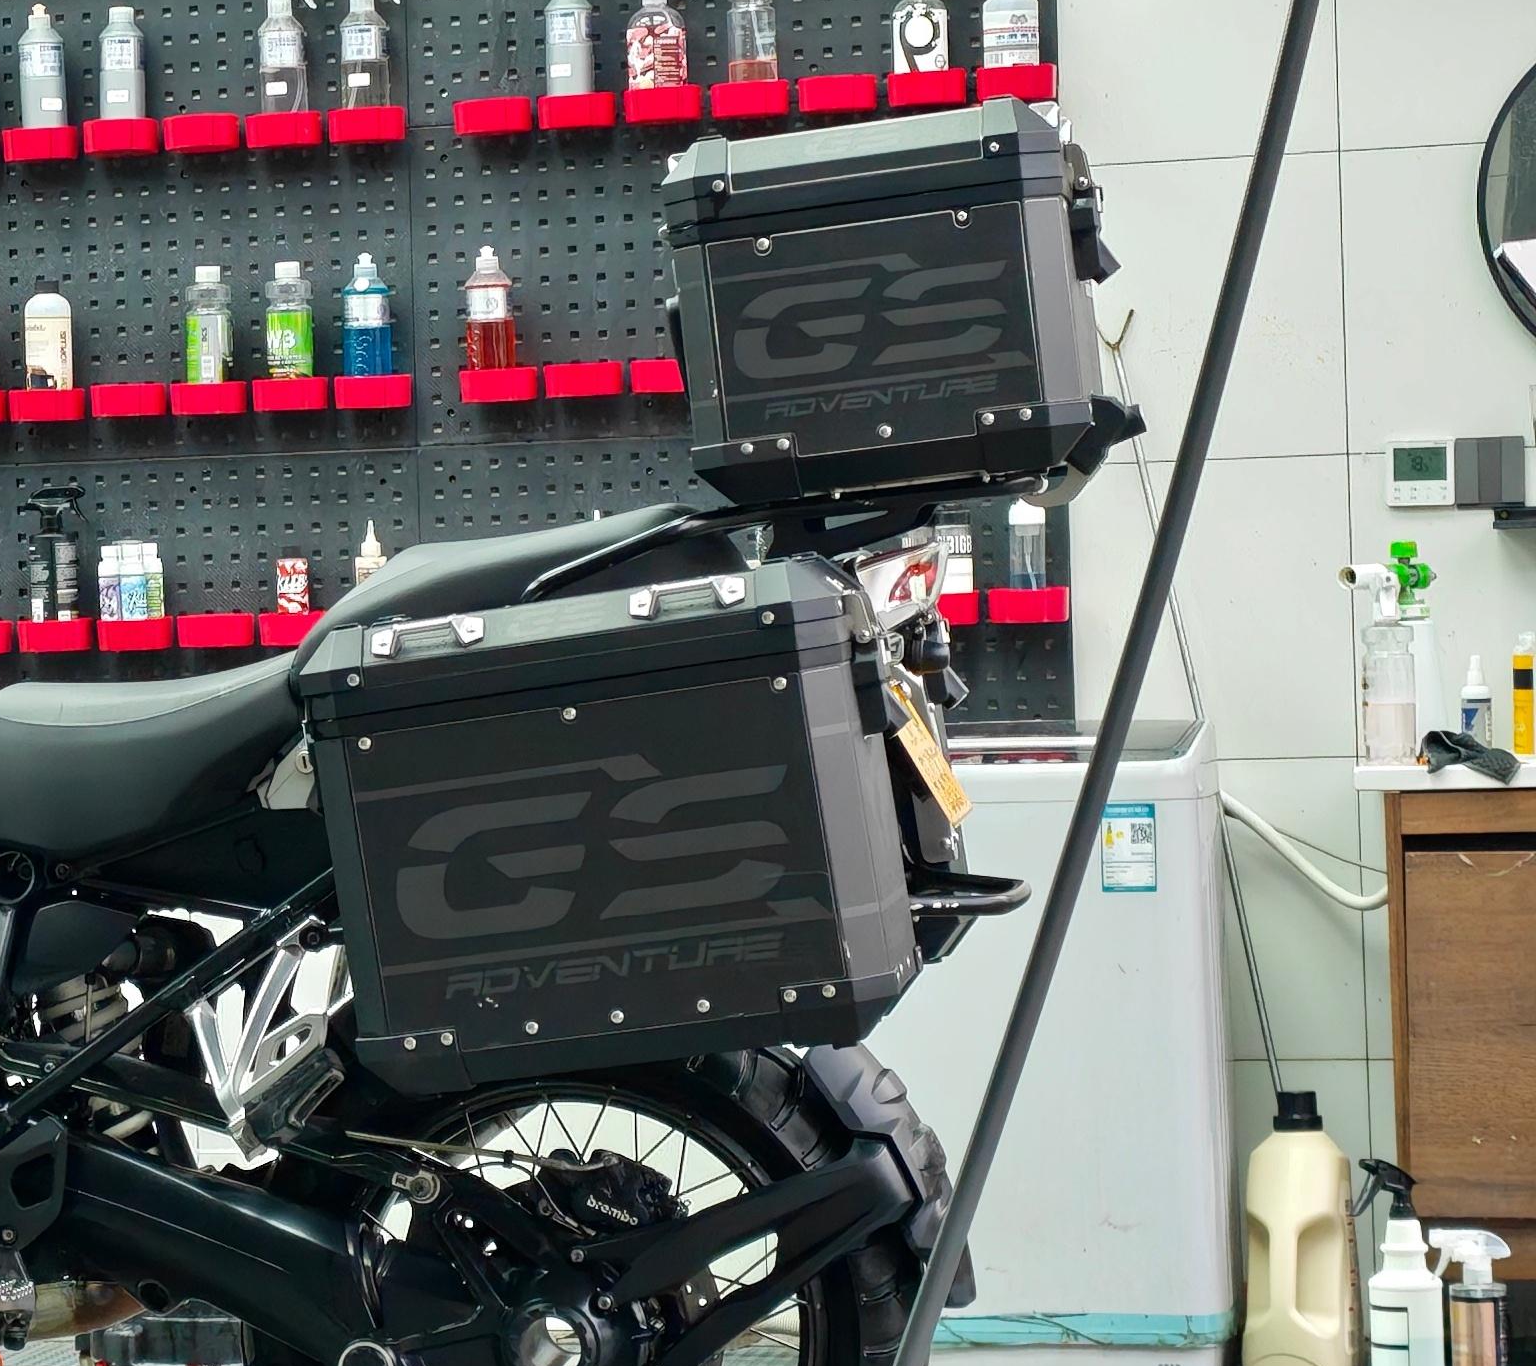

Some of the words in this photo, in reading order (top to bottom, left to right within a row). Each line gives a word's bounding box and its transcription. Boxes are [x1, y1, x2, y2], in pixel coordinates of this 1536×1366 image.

[732, 259, 1008, 379] GS
[765, 373, 998, 421] ADVENTURE
[396, 764, 788, 939] GS
[445, 934, 785, 999] ADVENTURE
[586, 1194, 639, 1226] brembo
